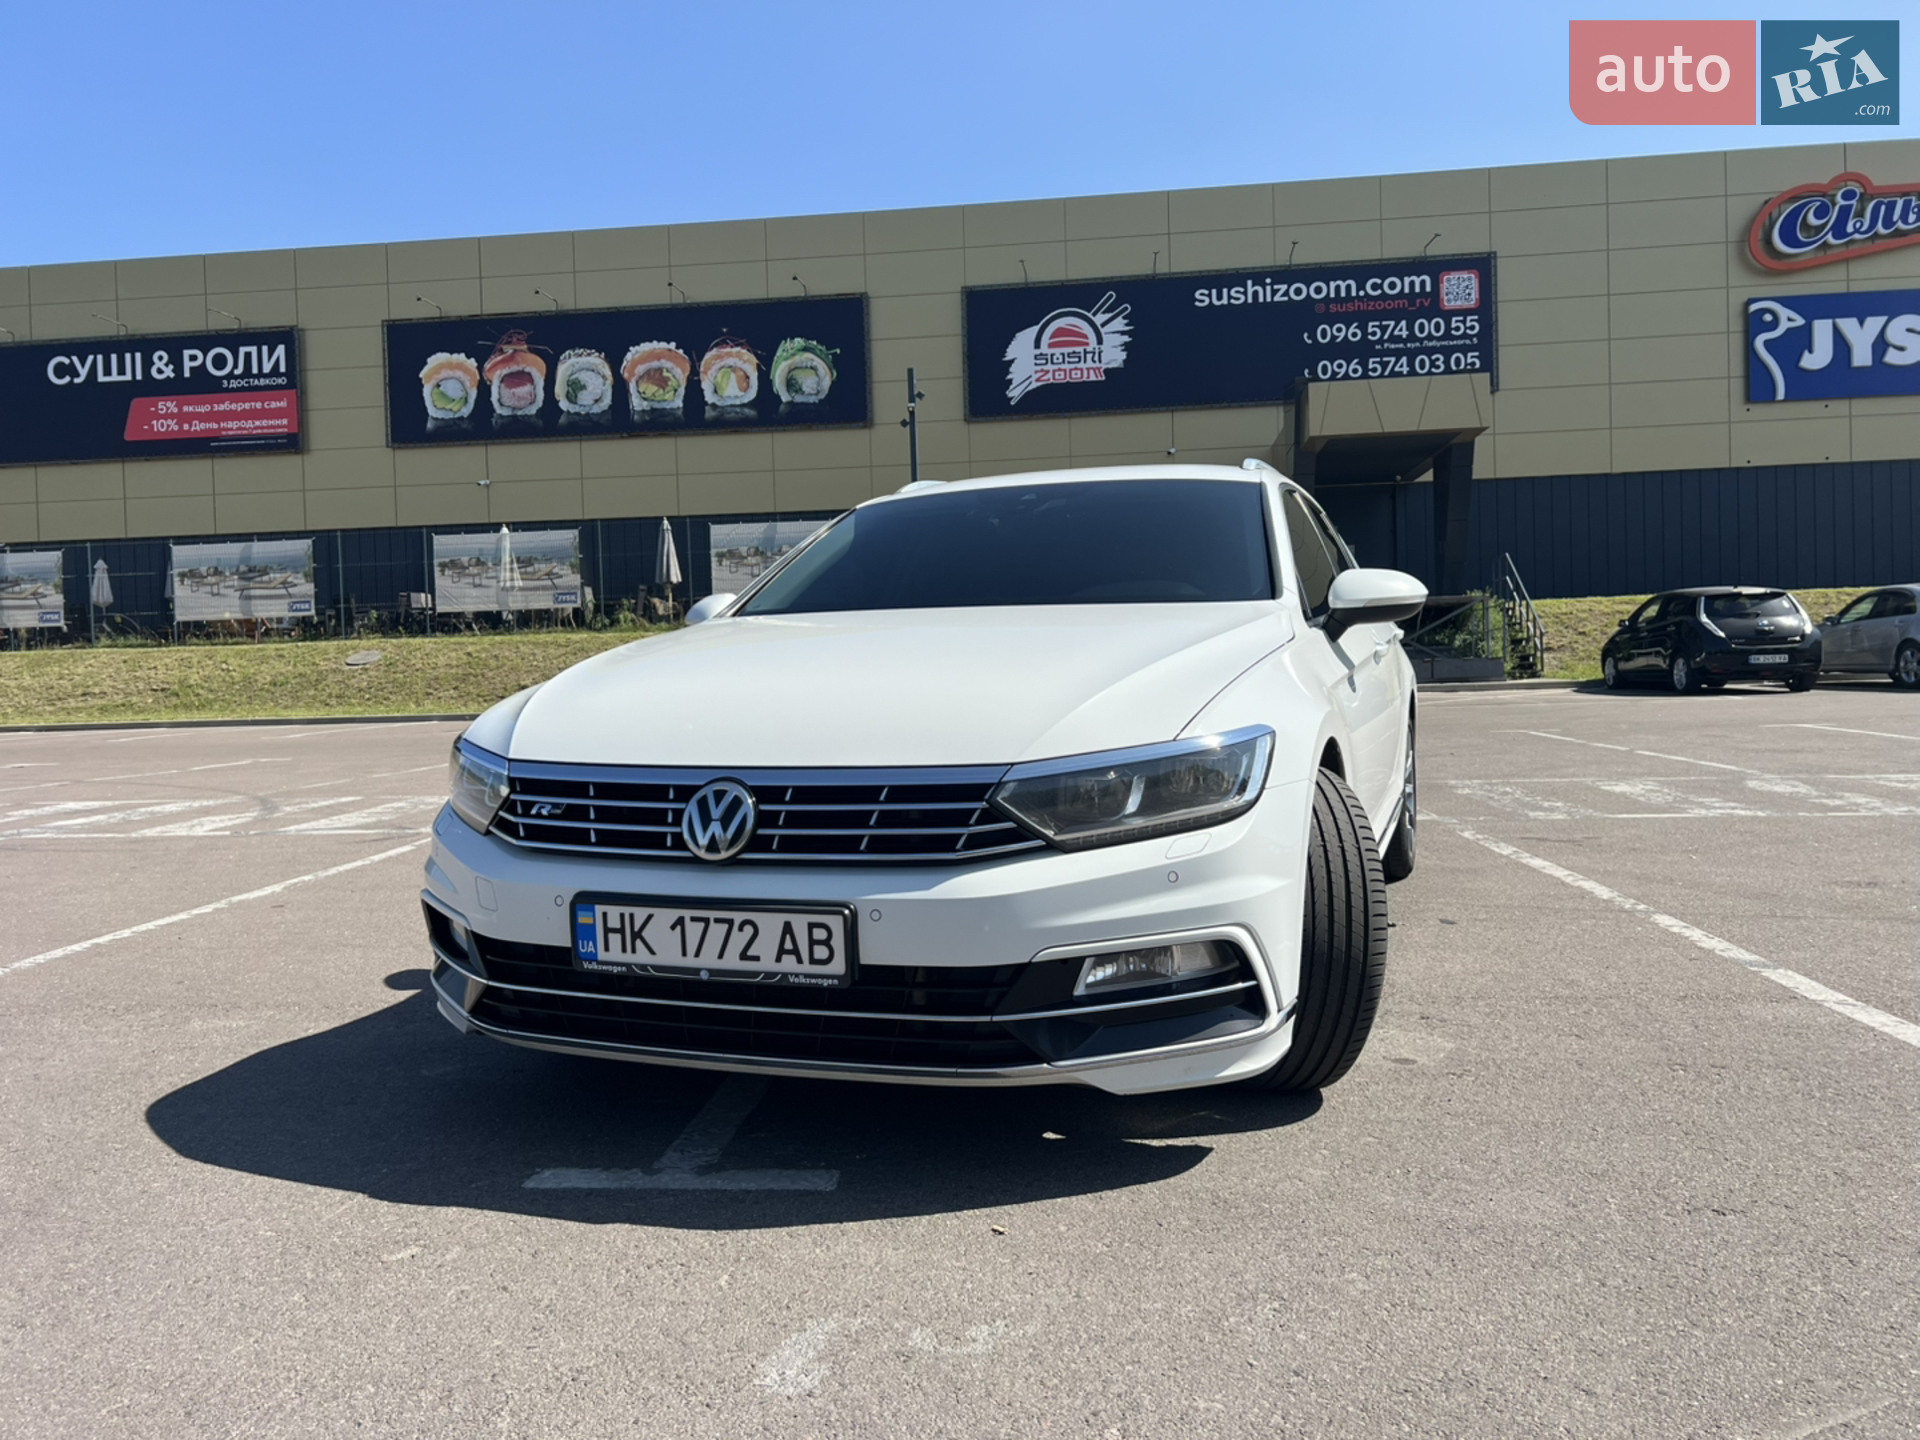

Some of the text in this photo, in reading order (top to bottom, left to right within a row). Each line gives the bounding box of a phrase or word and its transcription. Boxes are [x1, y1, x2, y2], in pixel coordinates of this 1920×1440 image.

[1194, 274, 1432, 307] sushizoom.com
[1329, 297, 1431, 314] sushizoom_rv
[1316, 315, 1480, 344] 096 574 00 55
[47, 344, 287, 385] СУШІ & РОЛИ
[1317, 351, 1481, 379] 096 574 03 05
[229, 377, 288, 389] ДОСТАВКОЮ
[158, 401, 178, 414] 5%
[183, 404, 211, 414] якщо
[213, 401, 262, 413] заберете
[264, 398, 288, 408] самі
[151, 418, 179, 431] 10%
[191, 420, 218, 431] День
[220, 416, 288, 430] народження
[579, 940, 596, 953] UA
[602, 911, 835, 966] HK 1772 AB
[582, 961, 627, 973] Volkswagen
[788, 974, 839, 985] Volkswagen
